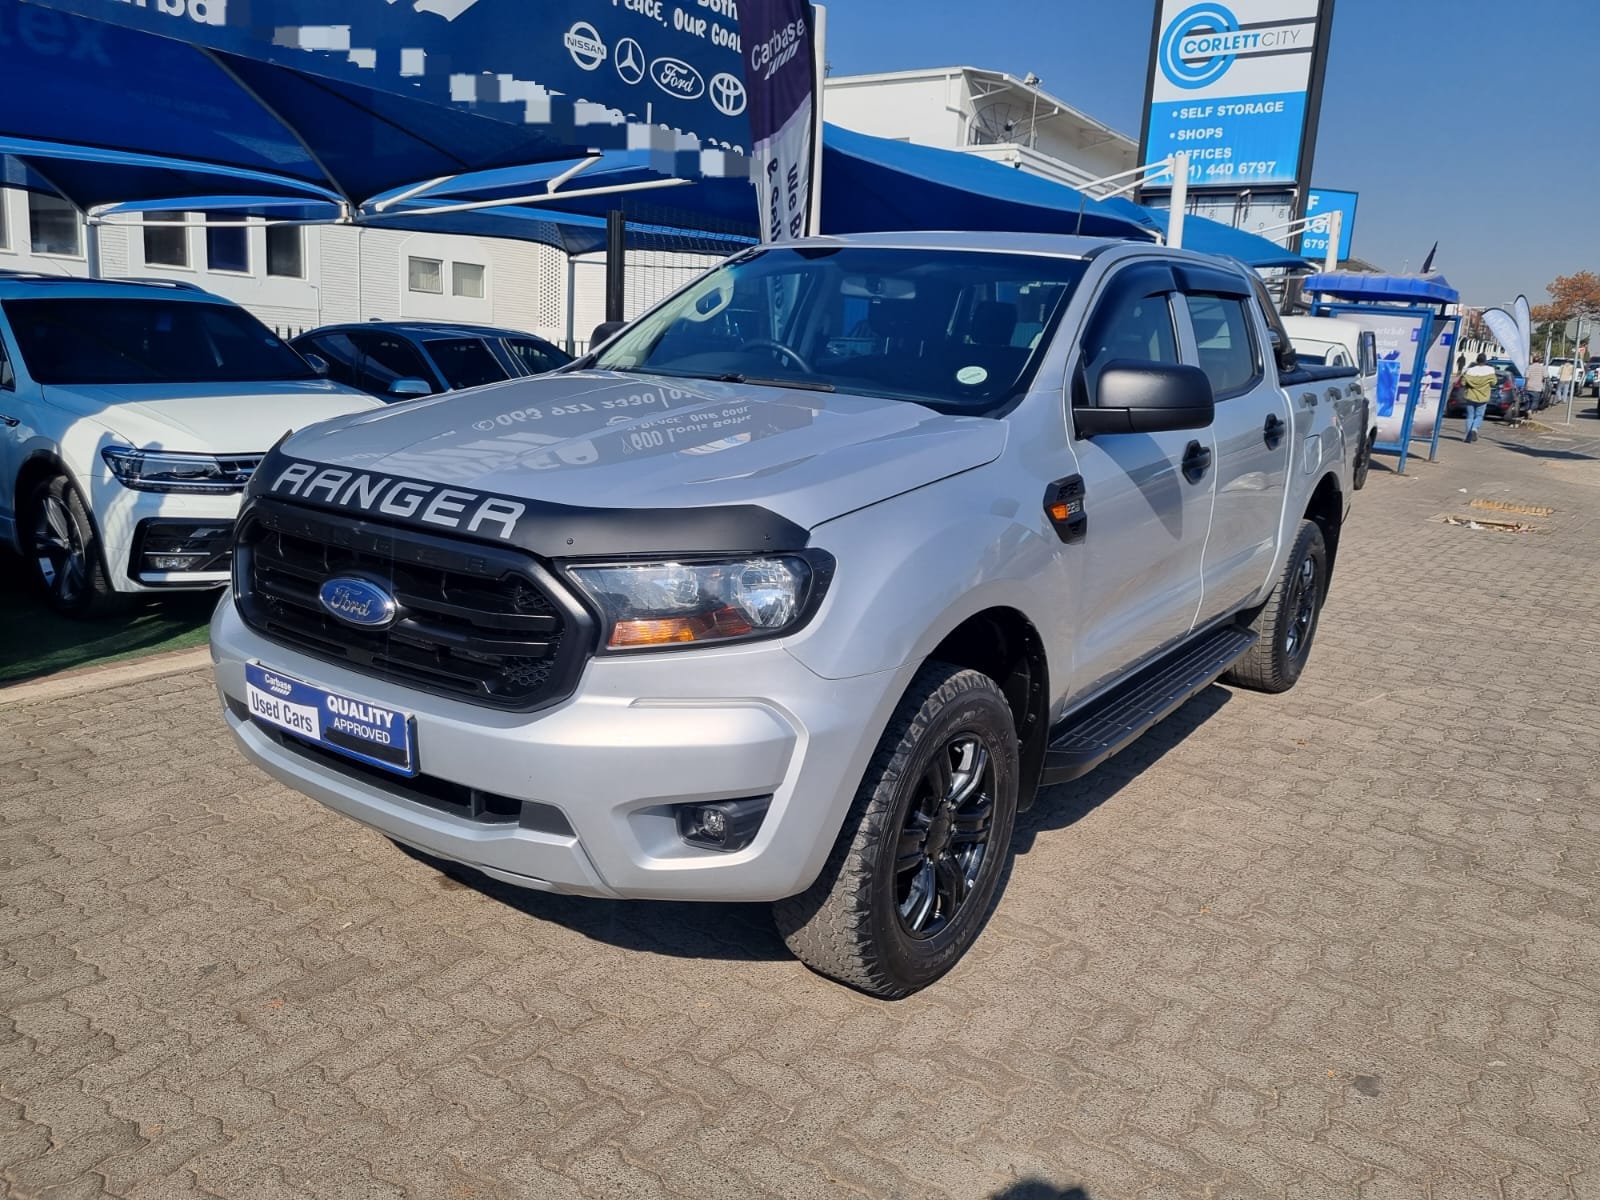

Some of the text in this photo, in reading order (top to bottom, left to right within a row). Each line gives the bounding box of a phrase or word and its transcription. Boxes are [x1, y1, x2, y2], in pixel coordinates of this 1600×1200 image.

[612, 0, 742, 53] EACE, OUR GOAL
[567, 37, 605, 56] NISSAN
[752, 18, 804, 71] Carbase
[661, 63, 695, 92] Ford
[1180, 101, 1284, 119] SELF STORAGE
[1177, 128, 1223, 140] SHOPS
[1206, 163, 1234, 176] 440
[1238, 161, 1276, 174] 6797
[271, 463, 526, 539] RANGER
[330, 585, 370, 616] Ford
[264, 674, 292, 691] Carbase
[252, 691, 313, 733] Used Cars
[326, 696, 394, 728] QUALITY
[334, 717, 391, 744] APPROVED
